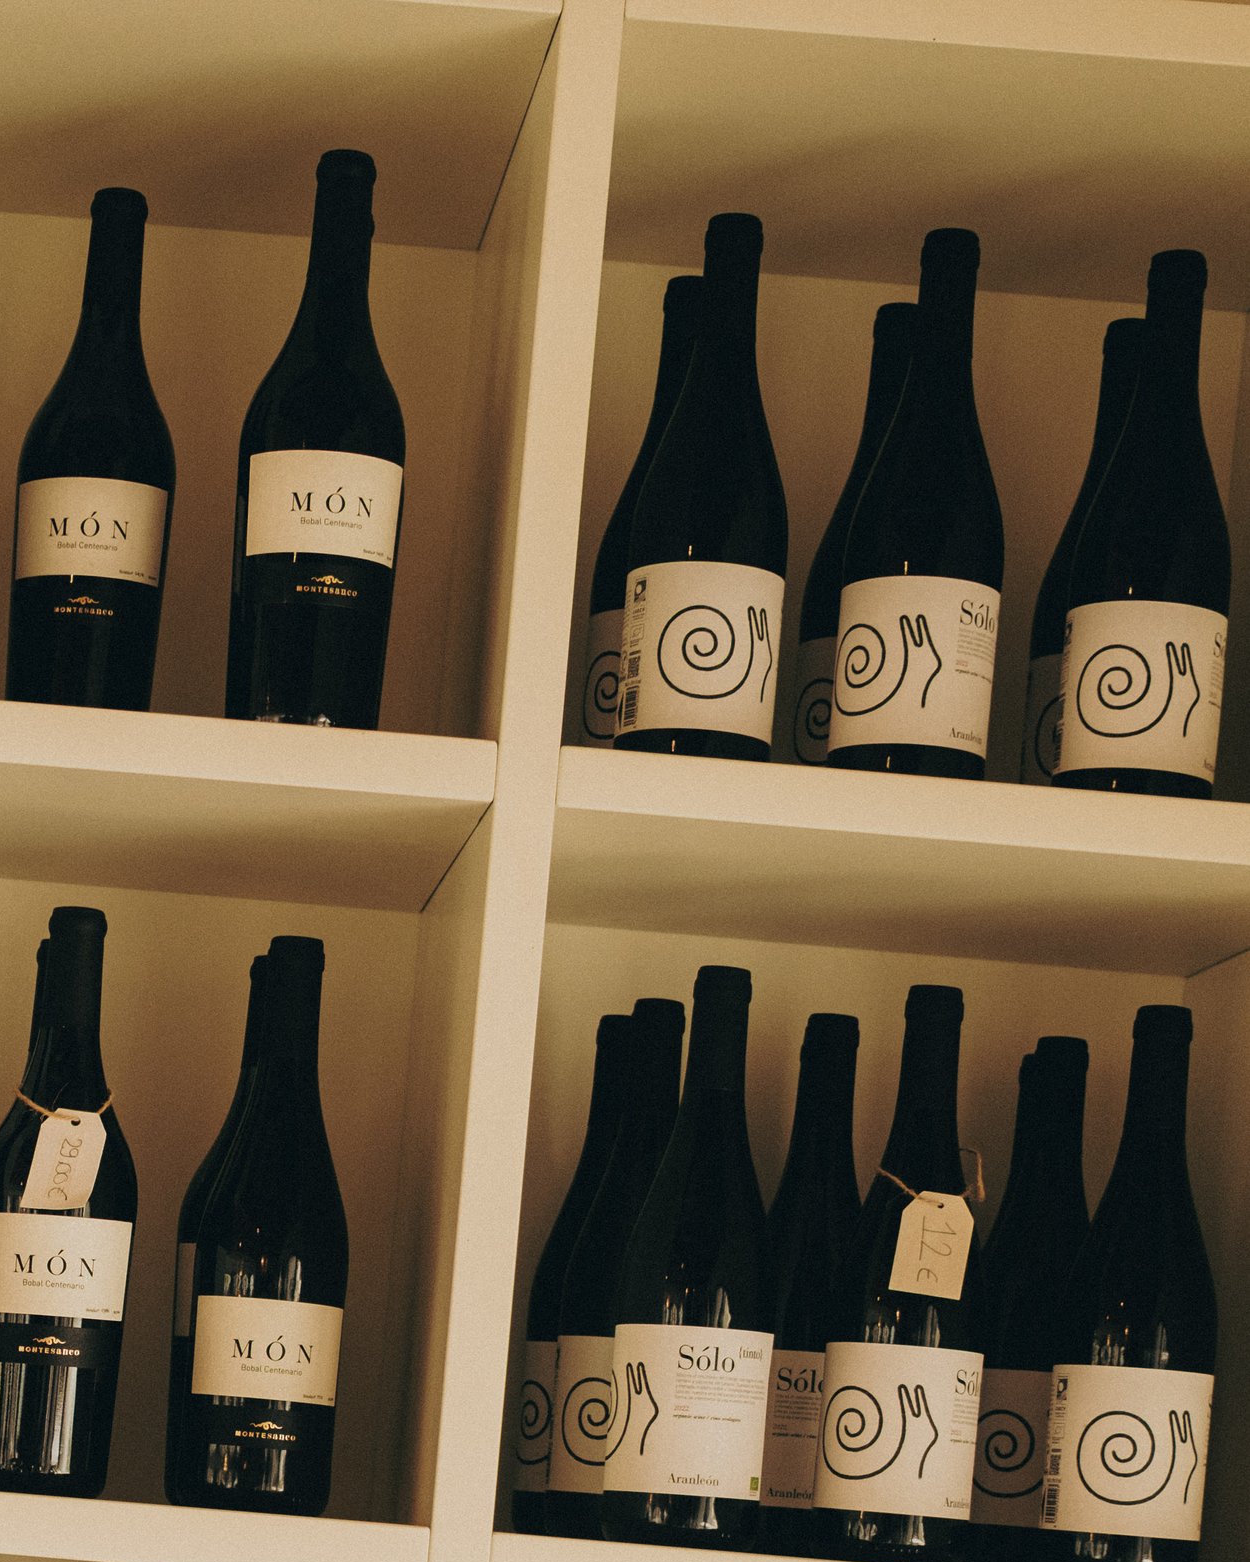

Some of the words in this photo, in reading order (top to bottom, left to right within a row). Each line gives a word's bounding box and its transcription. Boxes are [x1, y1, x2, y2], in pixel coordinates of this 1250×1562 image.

[290, 486, 373, 518] MÓN
[48, 511, 129, 541] MÓN
[300, 516, 322, 526] Bobal
[324, 517, 363, 530] Centenario
[56, 541, 77, 551] Bobal
[78, 541, 118, 552] Centenario
[959, 599, 996, 634] Sólo
[13, 1249, 97, 1278] MÓN
[22, 1277, 44, 1288] Bobal
[45, 1278, 85, 1290] Centenario
[231, 1335, 314, 1365] MÓN
[677, 1343, 736, 1374] Sólo
[241, 1363, 263, 1374] Bobal
[263, 1364, 303, 1377] Centenario
[668, 1472, 719, 1488] Aranleón
